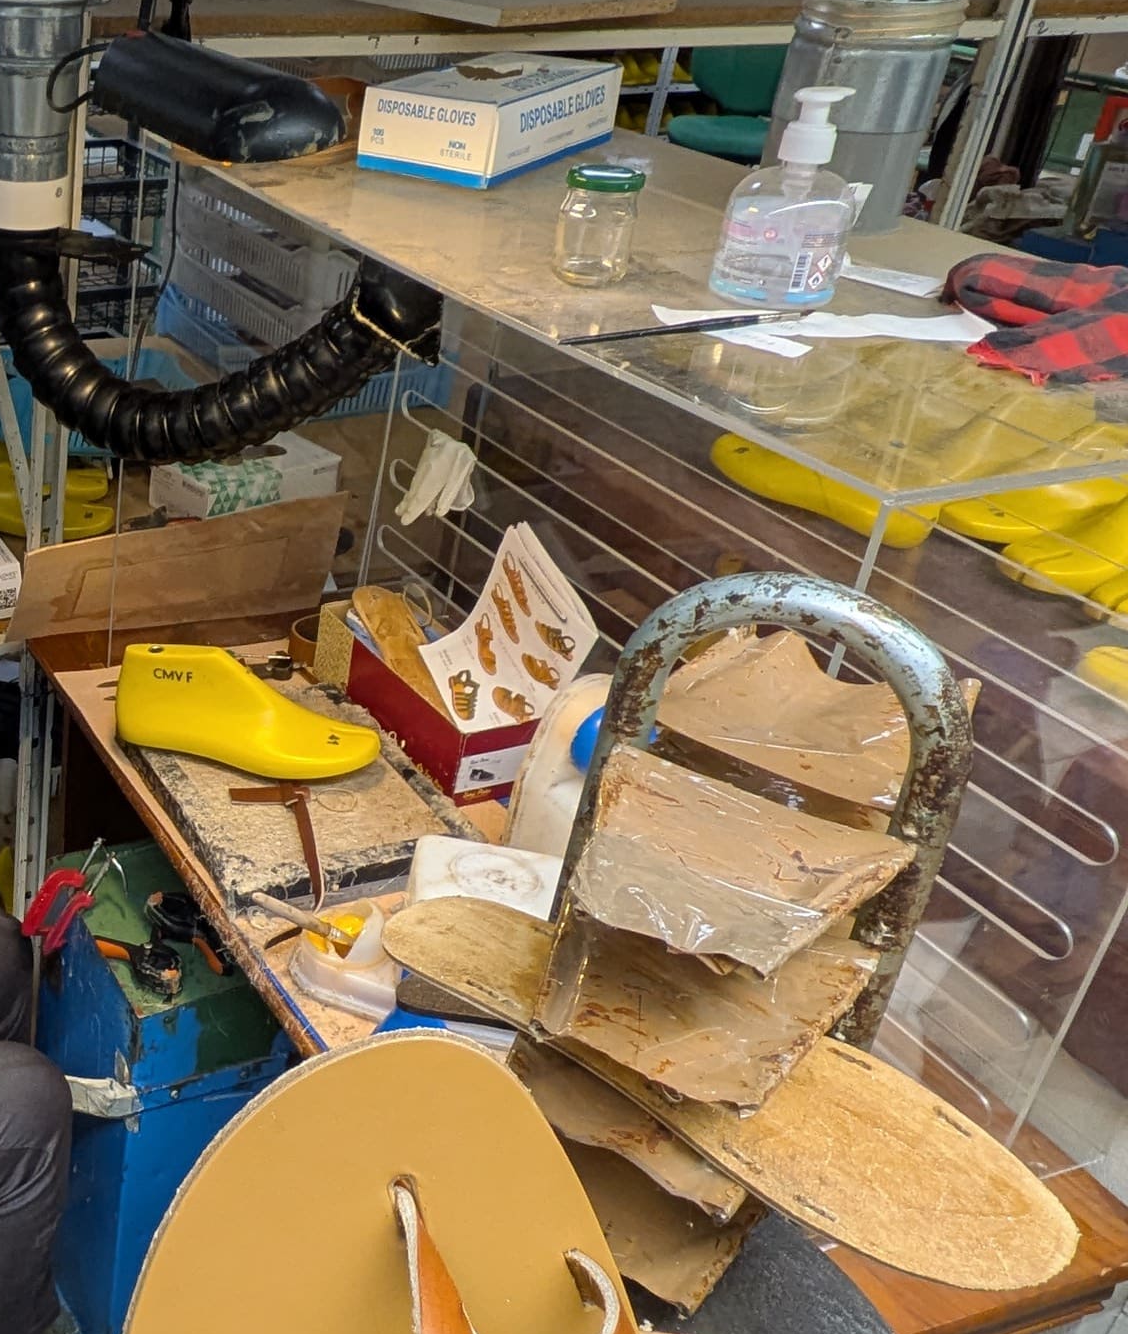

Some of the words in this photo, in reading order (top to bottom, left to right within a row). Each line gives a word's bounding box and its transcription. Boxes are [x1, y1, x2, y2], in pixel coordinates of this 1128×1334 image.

[377, 98, 436, 121] DISPOSABLE
[436, 107, 477, 127] GLOVES
[520, 96, 574, 134] DISPOSABLE
[574, 84, 606, 114] GLOVES
[447, 139, 467, 151] NON
[439, 148, 473, 162] STERILE
[153, 667, 184, 683] CMV
